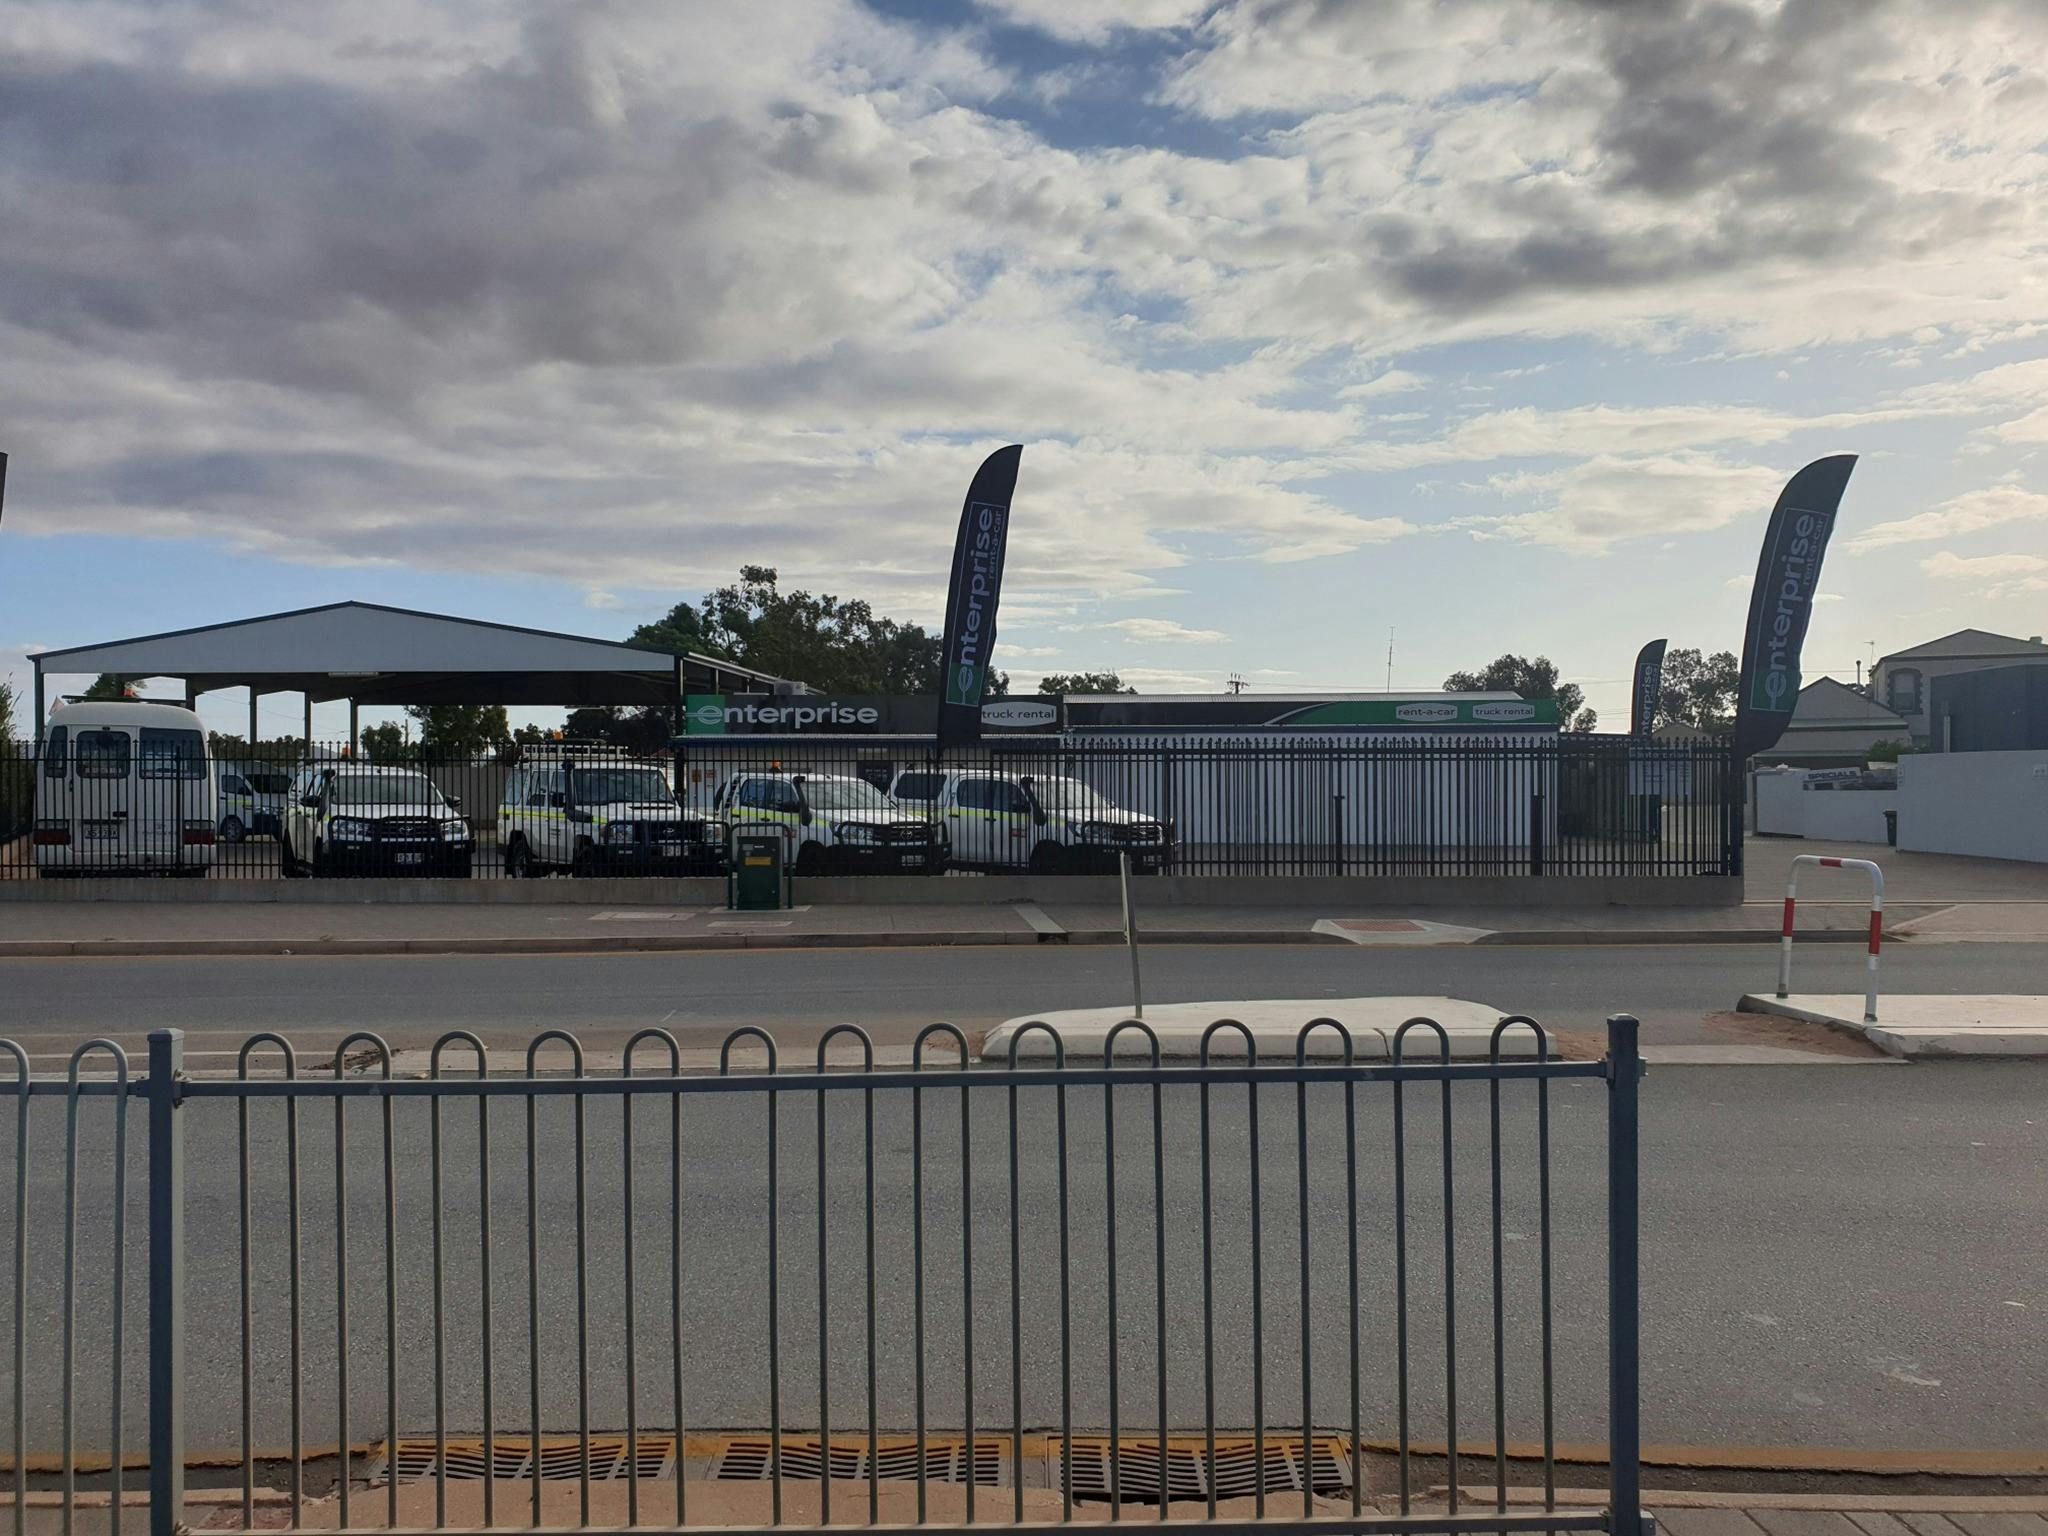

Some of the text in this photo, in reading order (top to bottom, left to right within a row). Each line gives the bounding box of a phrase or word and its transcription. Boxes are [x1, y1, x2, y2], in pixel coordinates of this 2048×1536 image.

[989, 511, 1002, 580] rent-a-car
[1803, 519, 1824, 586] rent-a-car
[958, 507, 993, 692] enterprise
[1765, 513, 1814, 698] enterprise
[696, 702, 879, 729] enterprise
[982, 709, 1055, 719] truck rental
[1398, 707, 1456, 716] rent-a-car
[1475, 707, 1534, 716] truck rental
[1642, 665, 1654, 736] nterprise
[1808, 770, 1858, 780] SPECIALS
